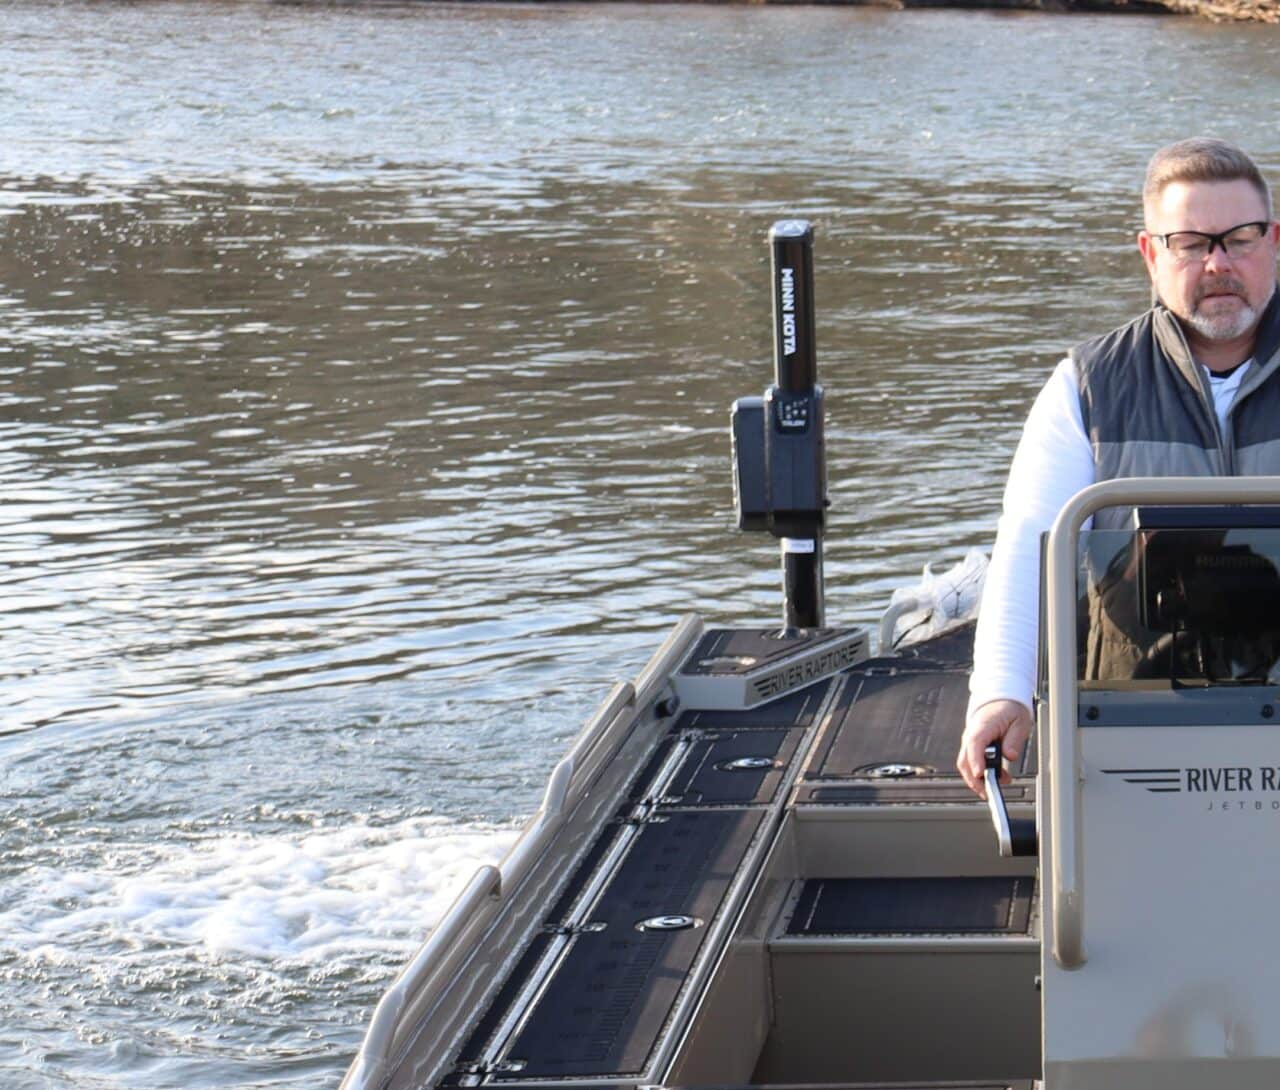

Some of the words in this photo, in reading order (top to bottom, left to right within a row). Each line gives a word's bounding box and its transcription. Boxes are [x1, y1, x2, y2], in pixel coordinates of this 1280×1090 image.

[781, 268, 795, 311] MINN
[783, 313, 796, 356] KOTA
[768, 666, 804, 694] RIVER
[805, 647, 849, 677] RAPTOR
[1185, 767, 1253, 792] RIVER
